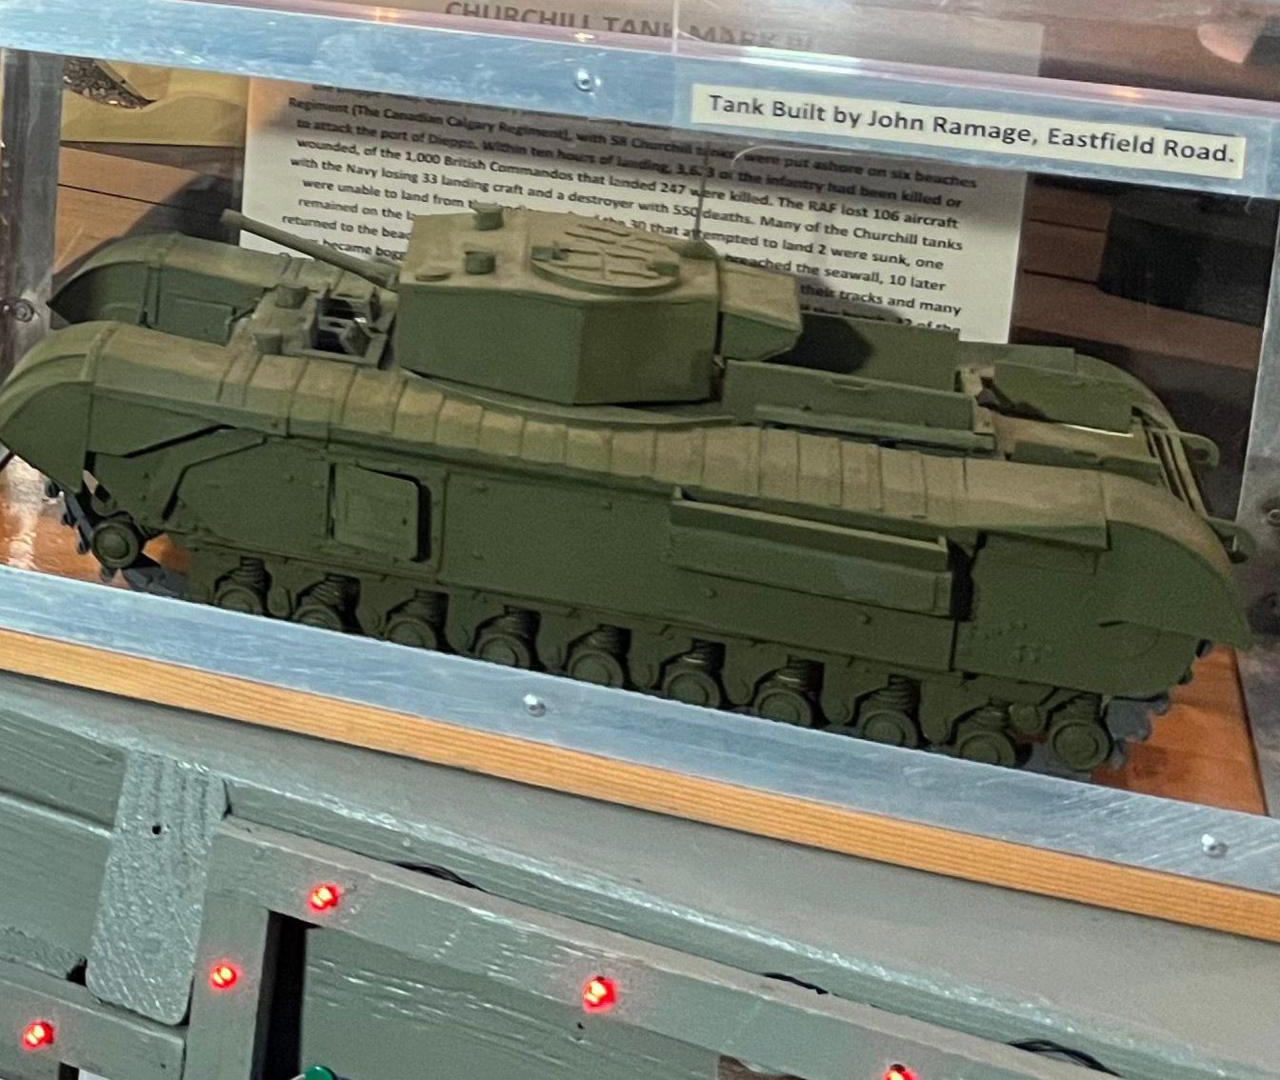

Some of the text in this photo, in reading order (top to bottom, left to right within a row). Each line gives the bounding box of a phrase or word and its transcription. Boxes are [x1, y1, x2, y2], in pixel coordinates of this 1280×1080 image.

[709, 94, 1235, 164] Tank Built by John Ramage, Eastfield Road.
[760, 215, 962, 251] Many of the Churchill tanks
